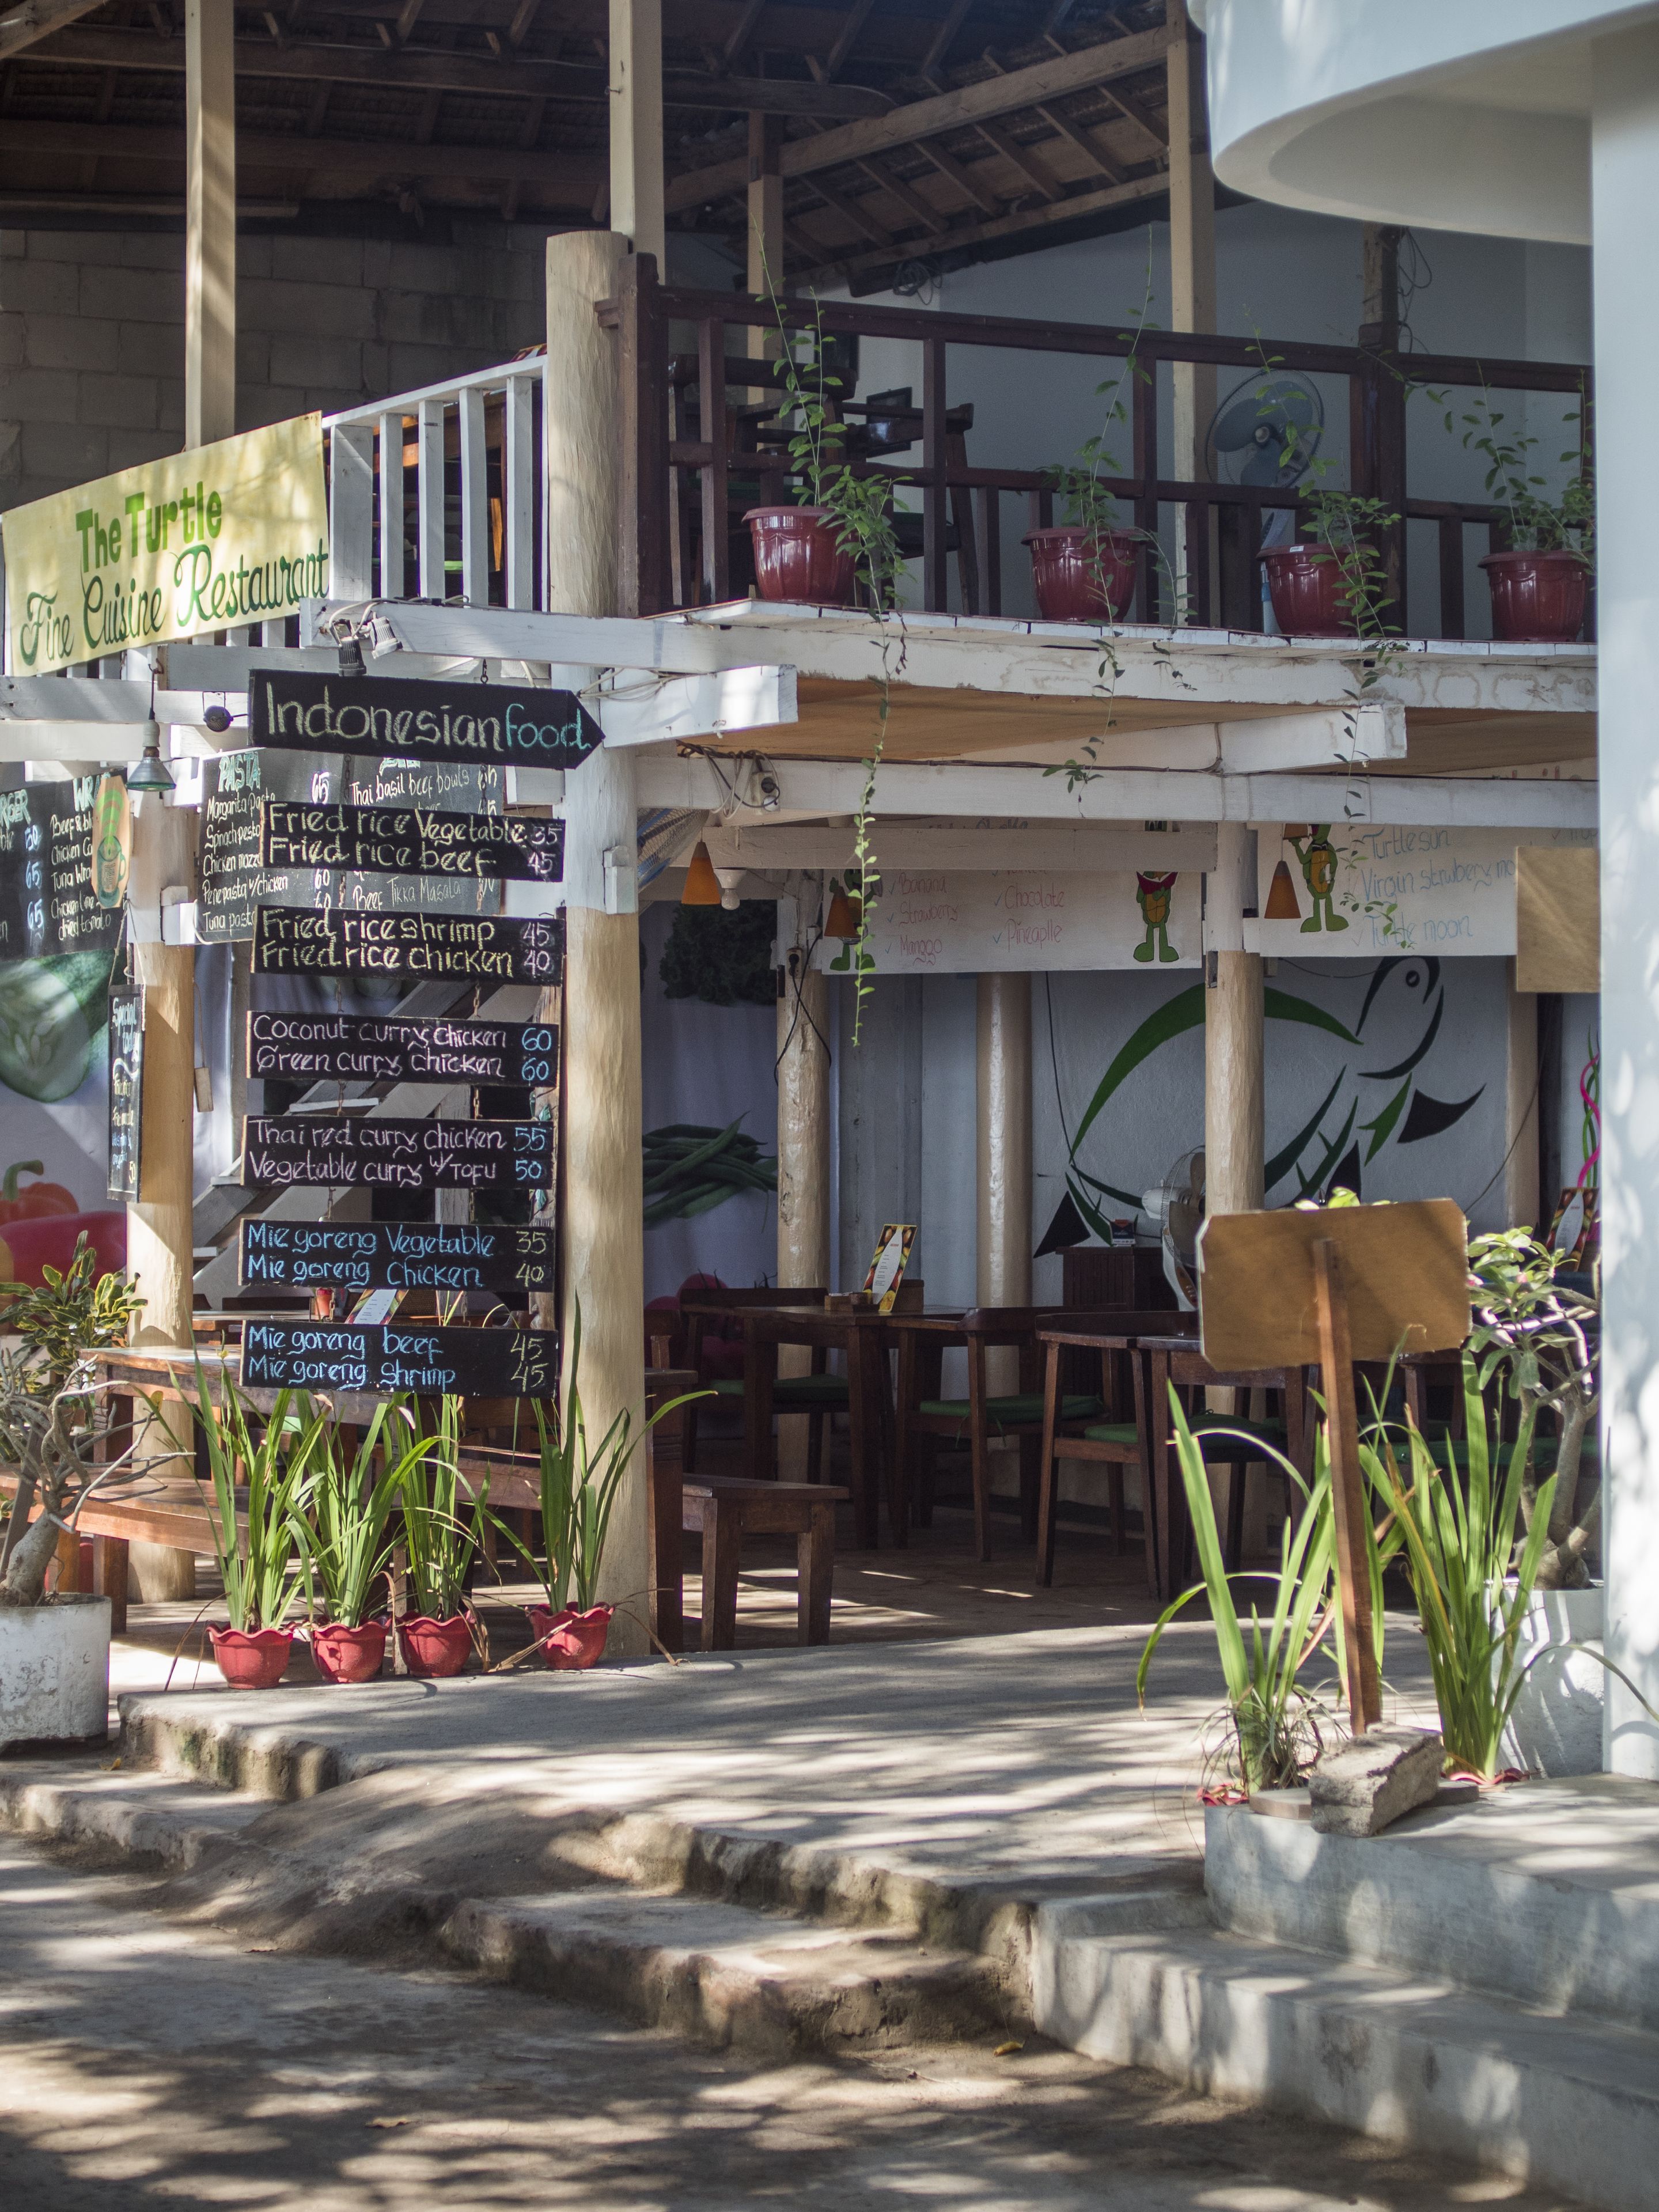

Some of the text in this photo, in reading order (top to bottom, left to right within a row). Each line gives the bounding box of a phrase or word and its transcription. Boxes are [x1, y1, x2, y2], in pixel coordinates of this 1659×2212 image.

[76, 481, 222, 573] The Turtle
[20, 538, 329, 666] Fine Cuisine Restaurant
[266, 681, 592, 751] Indonesian food
[218, 751, 261, 793] PASTA
[350, 781, 374, 806] Thai
[376, 772, 406, 802] basil
[408, 772, 433, 798] beef
[73, 772, 111, 812] WR
[206, 791, 248, 824] Margarita
[50, 814, 74, 841] Beef
[204, 820, 260, 855] Spinach pesto
[270, 802, 563, 847] Fried rice Vegetable 35
[1362, 826, 1416, 859] Turtle
[51, 844, 80, 866] Chicken
[203, 853, 236, 877] Chicken
[270, 833, 556, 877] Fried rice beef 45
[25, 861, 42, 889] 65
[51, 871, 74, 893] Tuna
[75, 862, 92, 884] Wra
[315, 869, 331, 890] 60
[898, 872, 948, 895] Banana
[1361, 867, 1414, 905] Virgin
[1496, 859, 1516, 879] mo
[51, 897, 79, 919] Chicken
[353, 884, 384, 911] Beef
[387, 876, 416, 908] Tikka
[420, 877, 461, 903] Masala
[1004, 882, 1066, 910] Chocolate
[27, 897, 44, 930] 65
[58, 910, 112, 941] dried tomato
[202, 911, 226, 933] Tuna
[263, 907, 551, 950] Fried rice shrimp 45
[898, 899, 960, 927] Strawberry
[260, 940, 551, 978] Fried rice chicken 40
[112, 997, 137, 1036] Special
[253, 1014, 355, 1040] Coconut
[359, 1022, 430, 1051] curry
[521, 1027, 552, 1051] 60
[256, 1044, 549, 1081] Green curry chicken 60
[248, 1119, 547, 1158] Thai red curry chicken 55
[249, 1149, 357, 1185] Vegetable
[363, 1162, 423, 1188] curry
[515, 1159, 542, 1181] 50
[248, 1222, 547, 1262] Mie goreng Vegetable 35
[248, 1253, 545, 1289] Mie goreng Chicken 40
[248, 1325, 546, 1364] Mie goreng beef 45
[248, 1354, 287, 1380] Mie
[288, 1361, 366, 1391] goreng
[510, 1361, 550, 1392] 45
